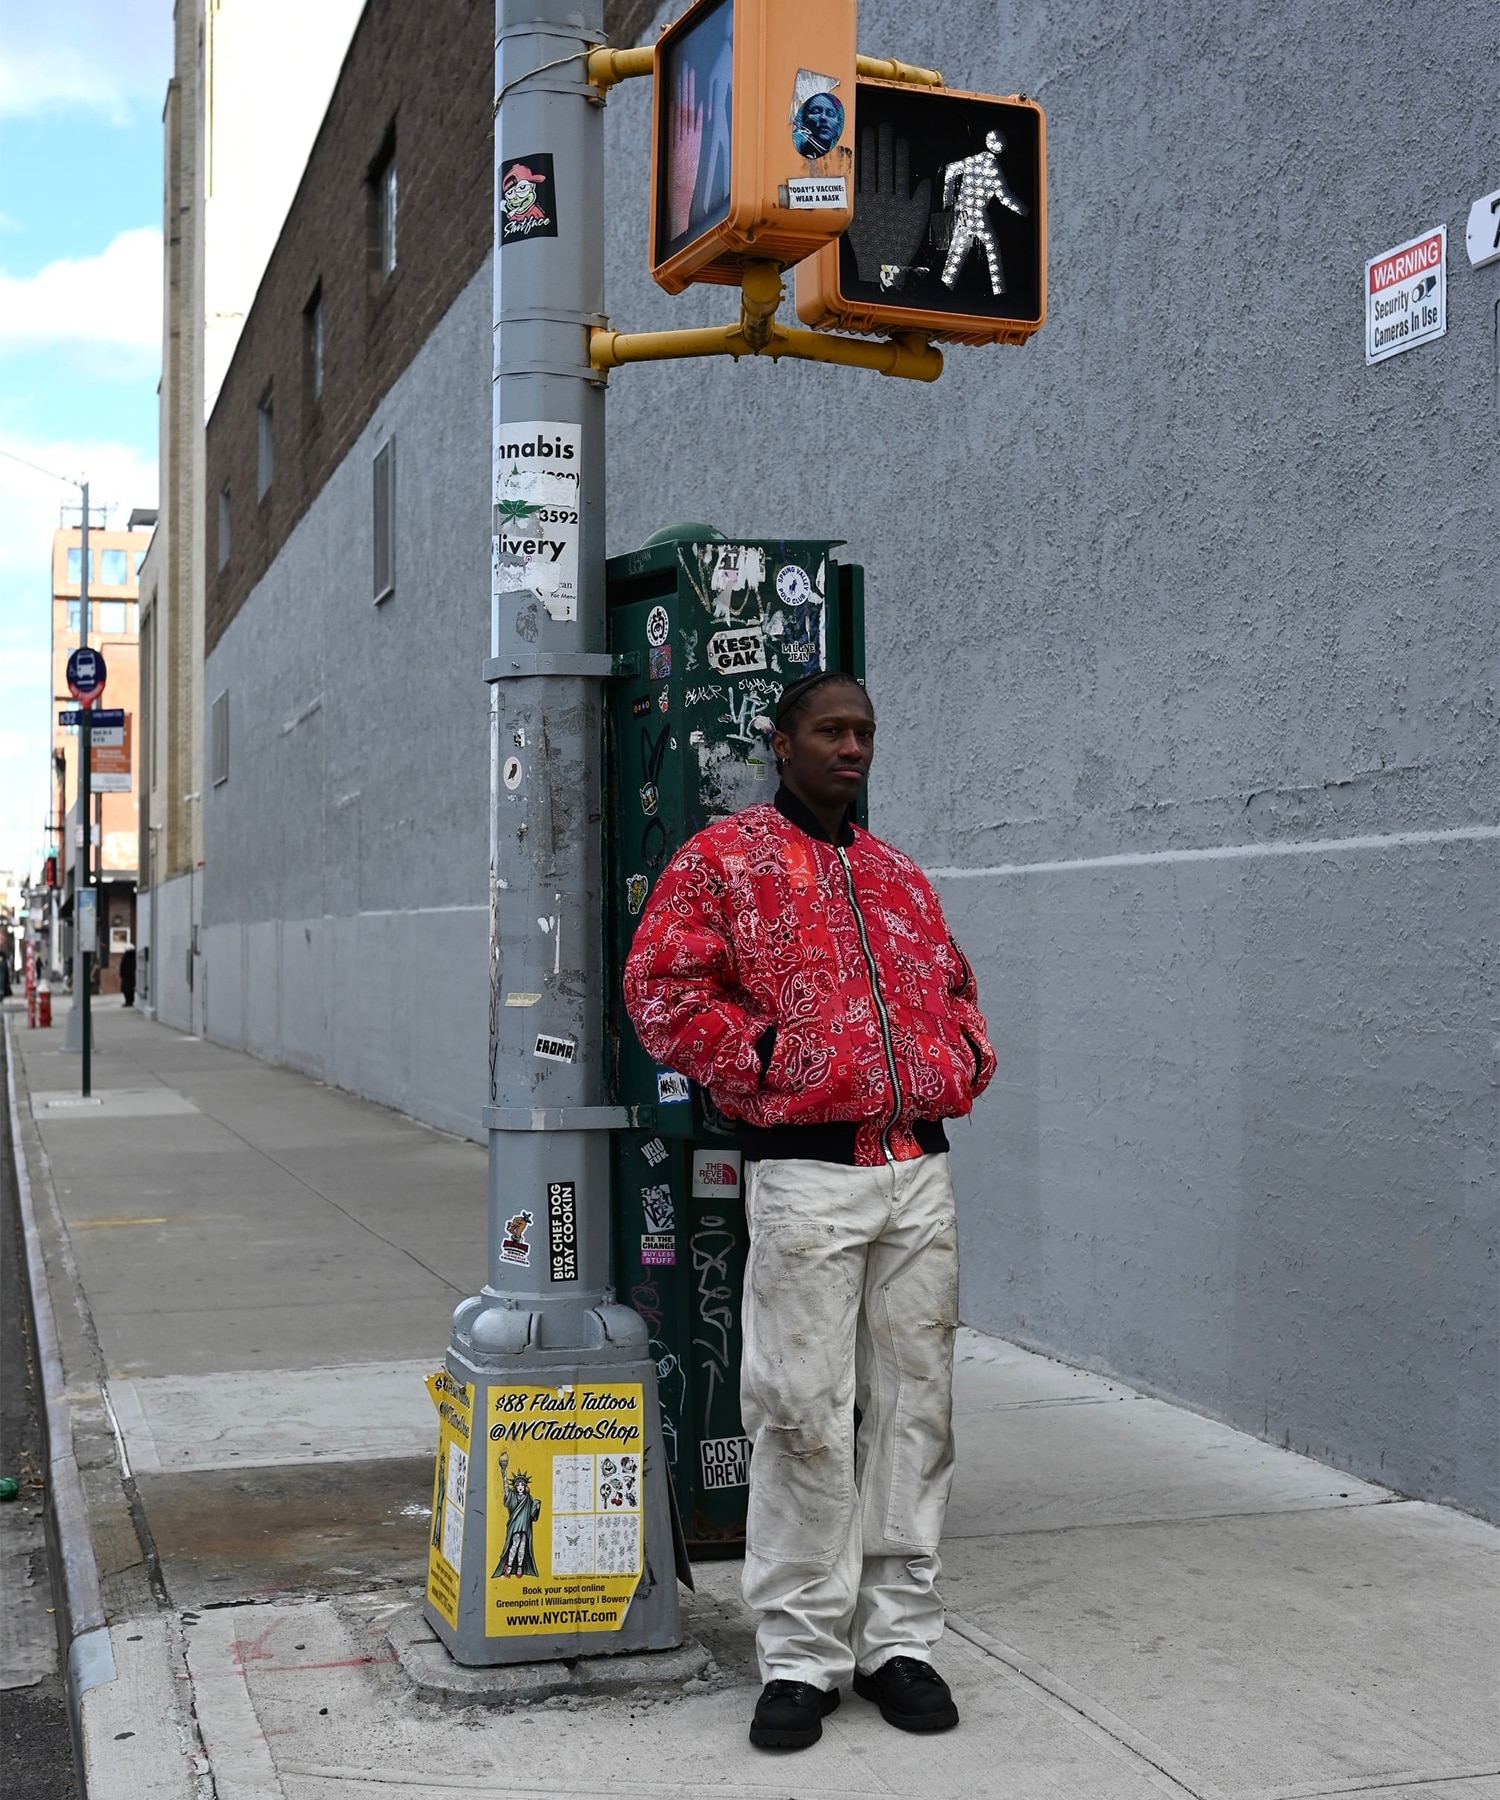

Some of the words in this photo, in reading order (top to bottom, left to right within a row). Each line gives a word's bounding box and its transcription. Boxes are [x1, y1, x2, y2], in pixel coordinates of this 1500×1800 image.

[822, 194, 840, 202] MASK
[1374, 241, 1439, 289] WARNING
[1374, 291, 1409, 321] Security
[1374, 319, 1409, 348] Cameras
[1411, 311, 1420, 332] In
[1422, 306, 1438, 328] Use
[540, 509, 578, 524] 3592
[778, 566, 796, 583] SPRING
[796, 567, 809, 592] VALLEY
[778, 588, 791, 604] POLO
[792, 593, 806, 604] CLUB
[718, 650, 759, 668] GAK
[789, 653, 809, 661] JEAN
[641, 1138, 665, 1160] VELO
[648, 1150, 670, 1167] FUK
[550, 1183, 562, 1215] DOG
[562, 1187, 574, 1243] COOKIN
[552, 1219, 563, 1252] CHEF
[553, 1256, 564, 1280] BIG
[564, 1246, 575, 1279] STAY
[494, 1393, 528, 1413] $88
[529, 1391, 576, 1412] Flash
[581, 1391, 638, 1410] Tattoos
[490, 1418, 640, 1445] @NYCTattooShop
[702, 1439, 748, 1465] COST
[704, 1461, 747, 1487] DREW
[496, 1598, 539, 1608] Greenpoint
[545, 1596, 595, 1606] Williamsburg
[601, 1595, 631, 1604] Bowery
[522, 1586, 542, 1595] Book
[544, 1587, 561, 1596] your
[563, 1585, 580, 1594] spot
[581, 1584, 605, 1592] online
[506, 1609, 617, 1626] www.NYCTAT.com
